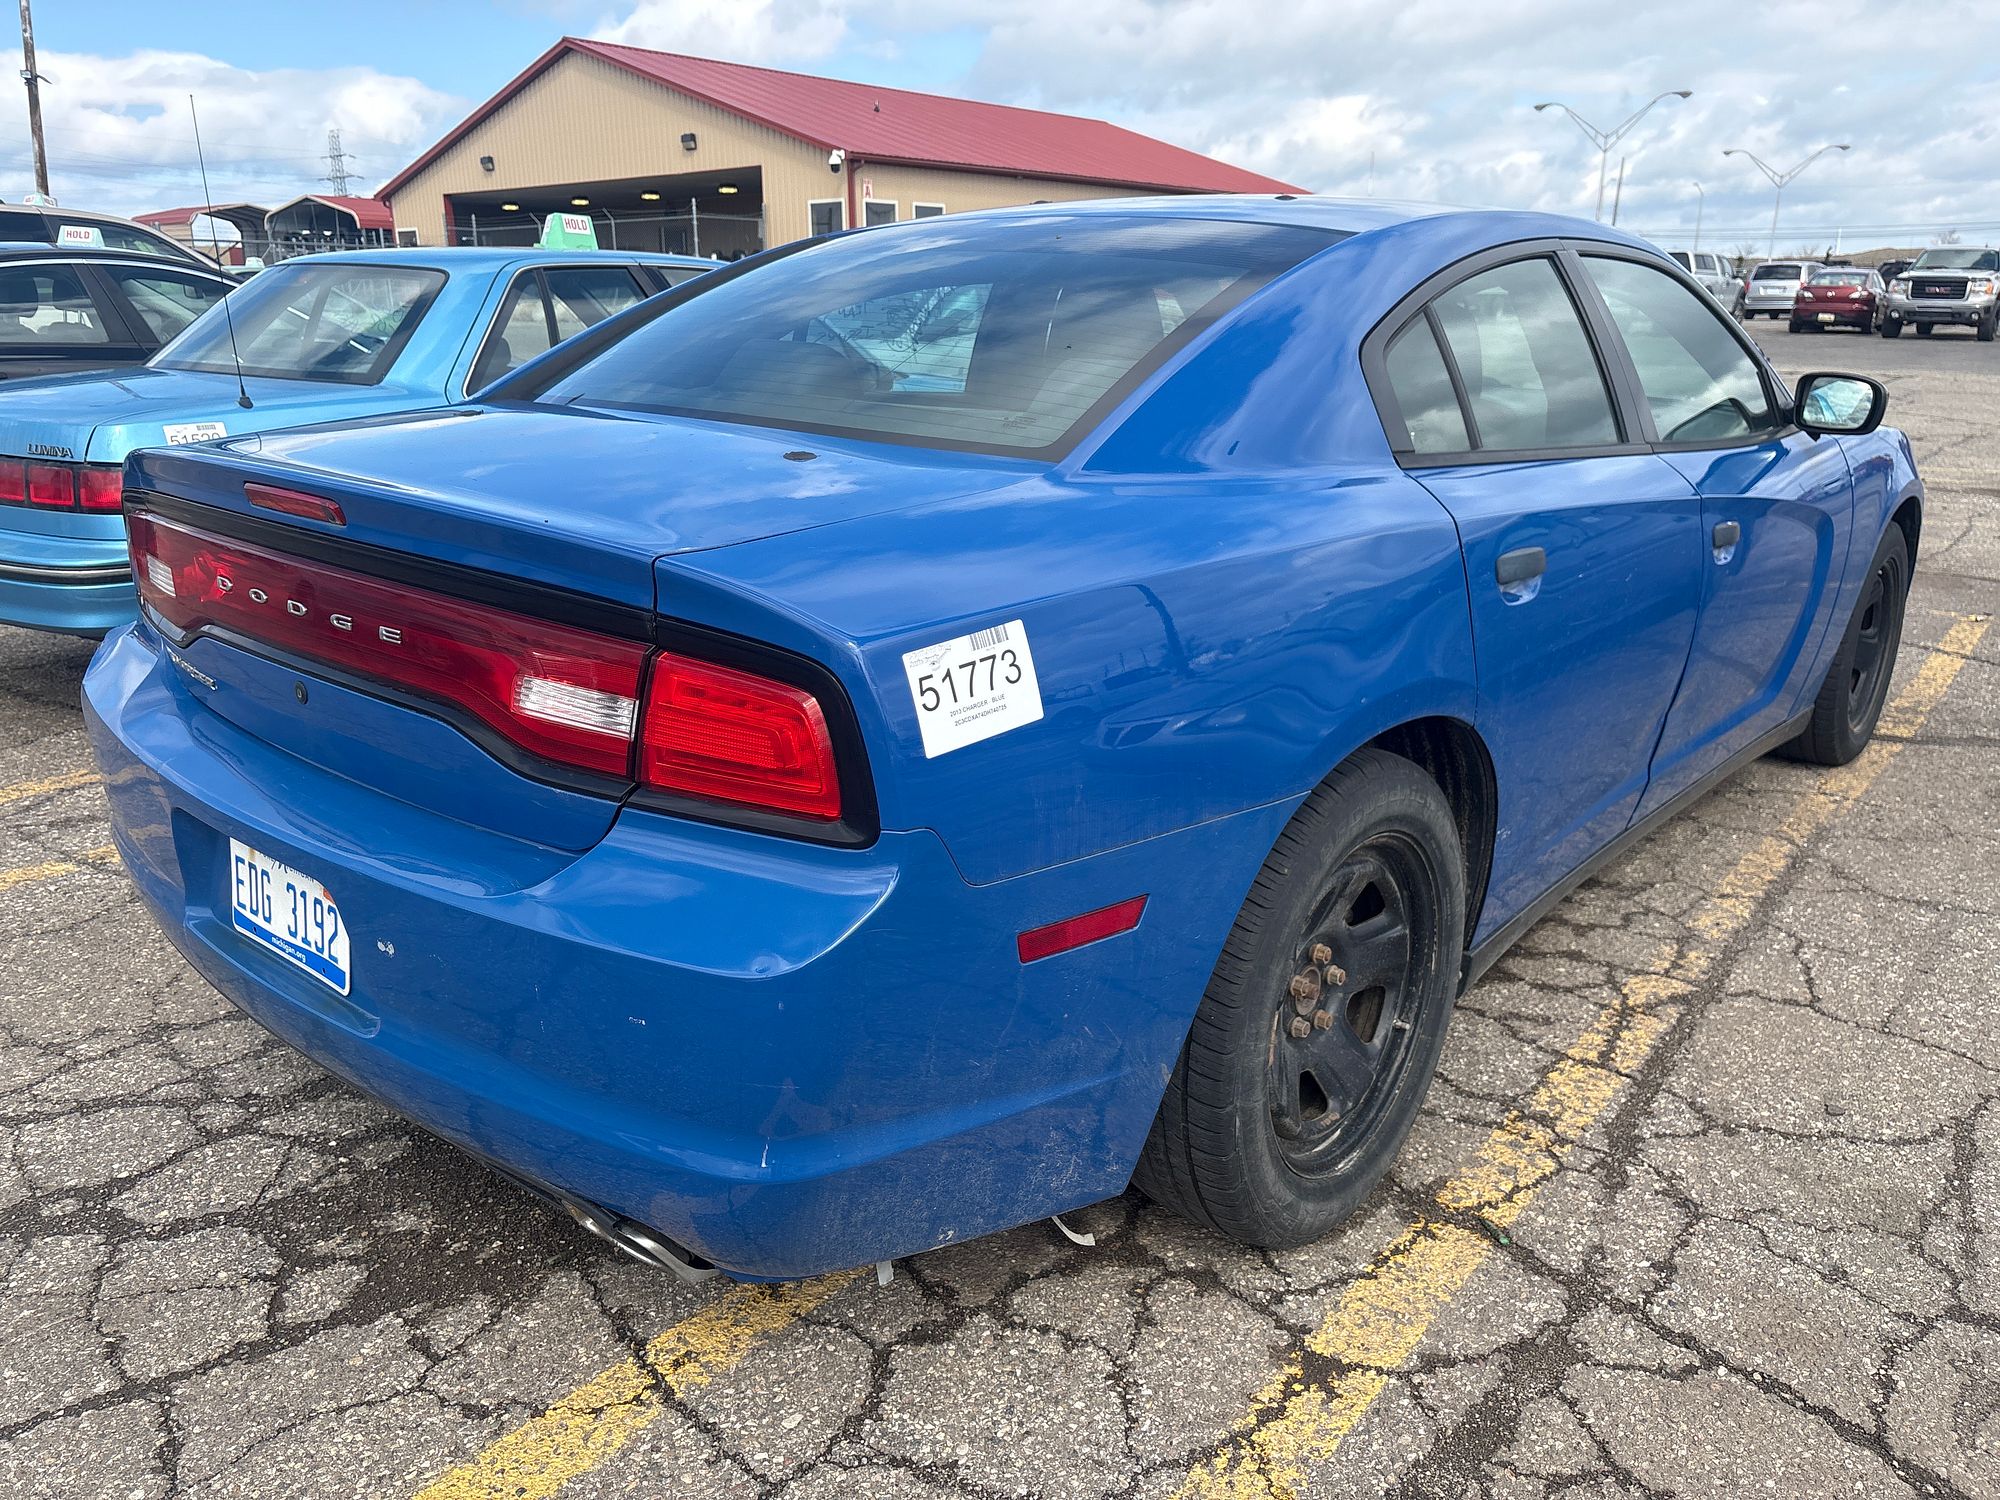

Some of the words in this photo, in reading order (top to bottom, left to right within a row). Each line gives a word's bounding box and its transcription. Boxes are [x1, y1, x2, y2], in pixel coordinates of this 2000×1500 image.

[66, 229, 90, 240] HOLD
[564, 217, 588, 231] HOLD
[27, 443, 74, 459] LUMINA
[216, 574, 402, 645] DODGE
[918, 648, 1022, 712] 51773
[991, 693, 1006, 704] BLUE
[235, 854, 272, 925] EDG
[285, 881, 339, 965] 3192
[271, 935, 307, 964] michigan.org
